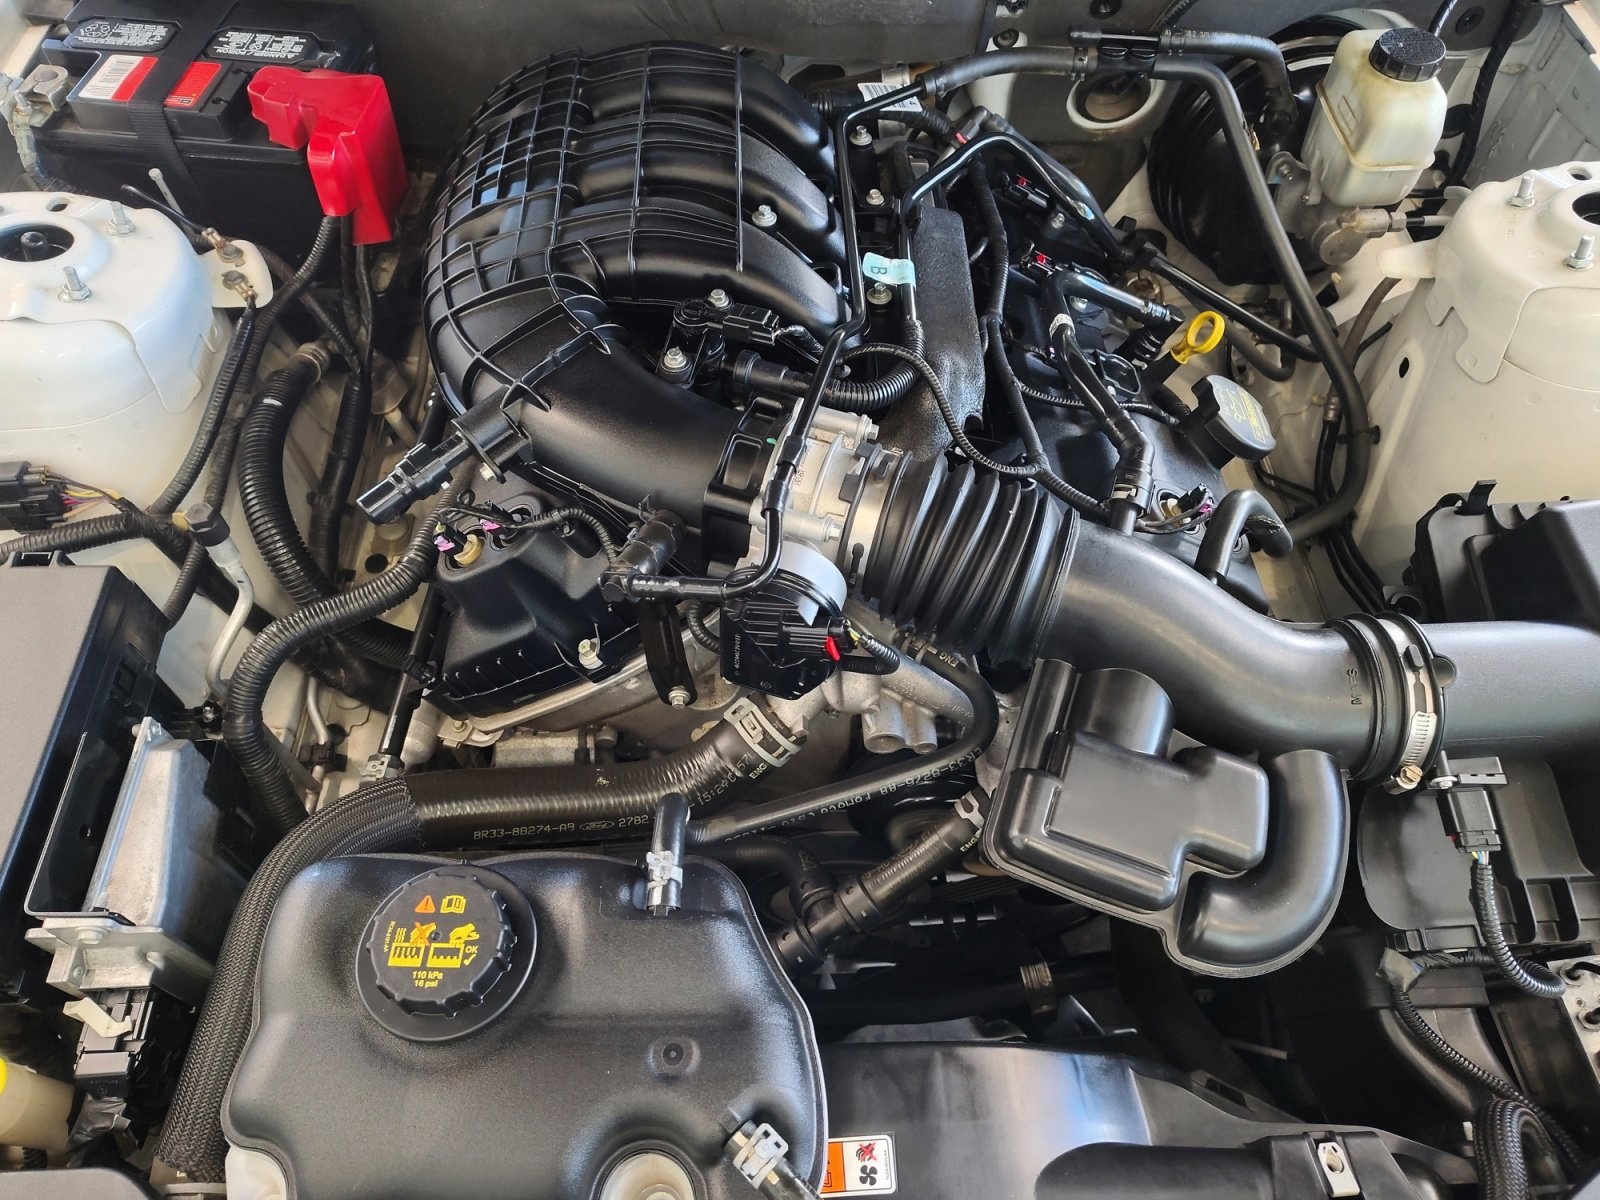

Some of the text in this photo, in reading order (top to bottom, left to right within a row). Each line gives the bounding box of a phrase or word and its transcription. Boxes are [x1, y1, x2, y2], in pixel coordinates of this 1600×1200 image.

[215, 47, 247, 56] POISON
[870, 265, 888, 275] B
[939, 652, 959, 667] ENG
[748, 762, 769, 780] ENG
[618, 814, 650, 828] 2782
[959, 836, 979, 853] ENG
[413, 971, 443, 979] 110 kPa
[425, 980, 438, 988] psi
